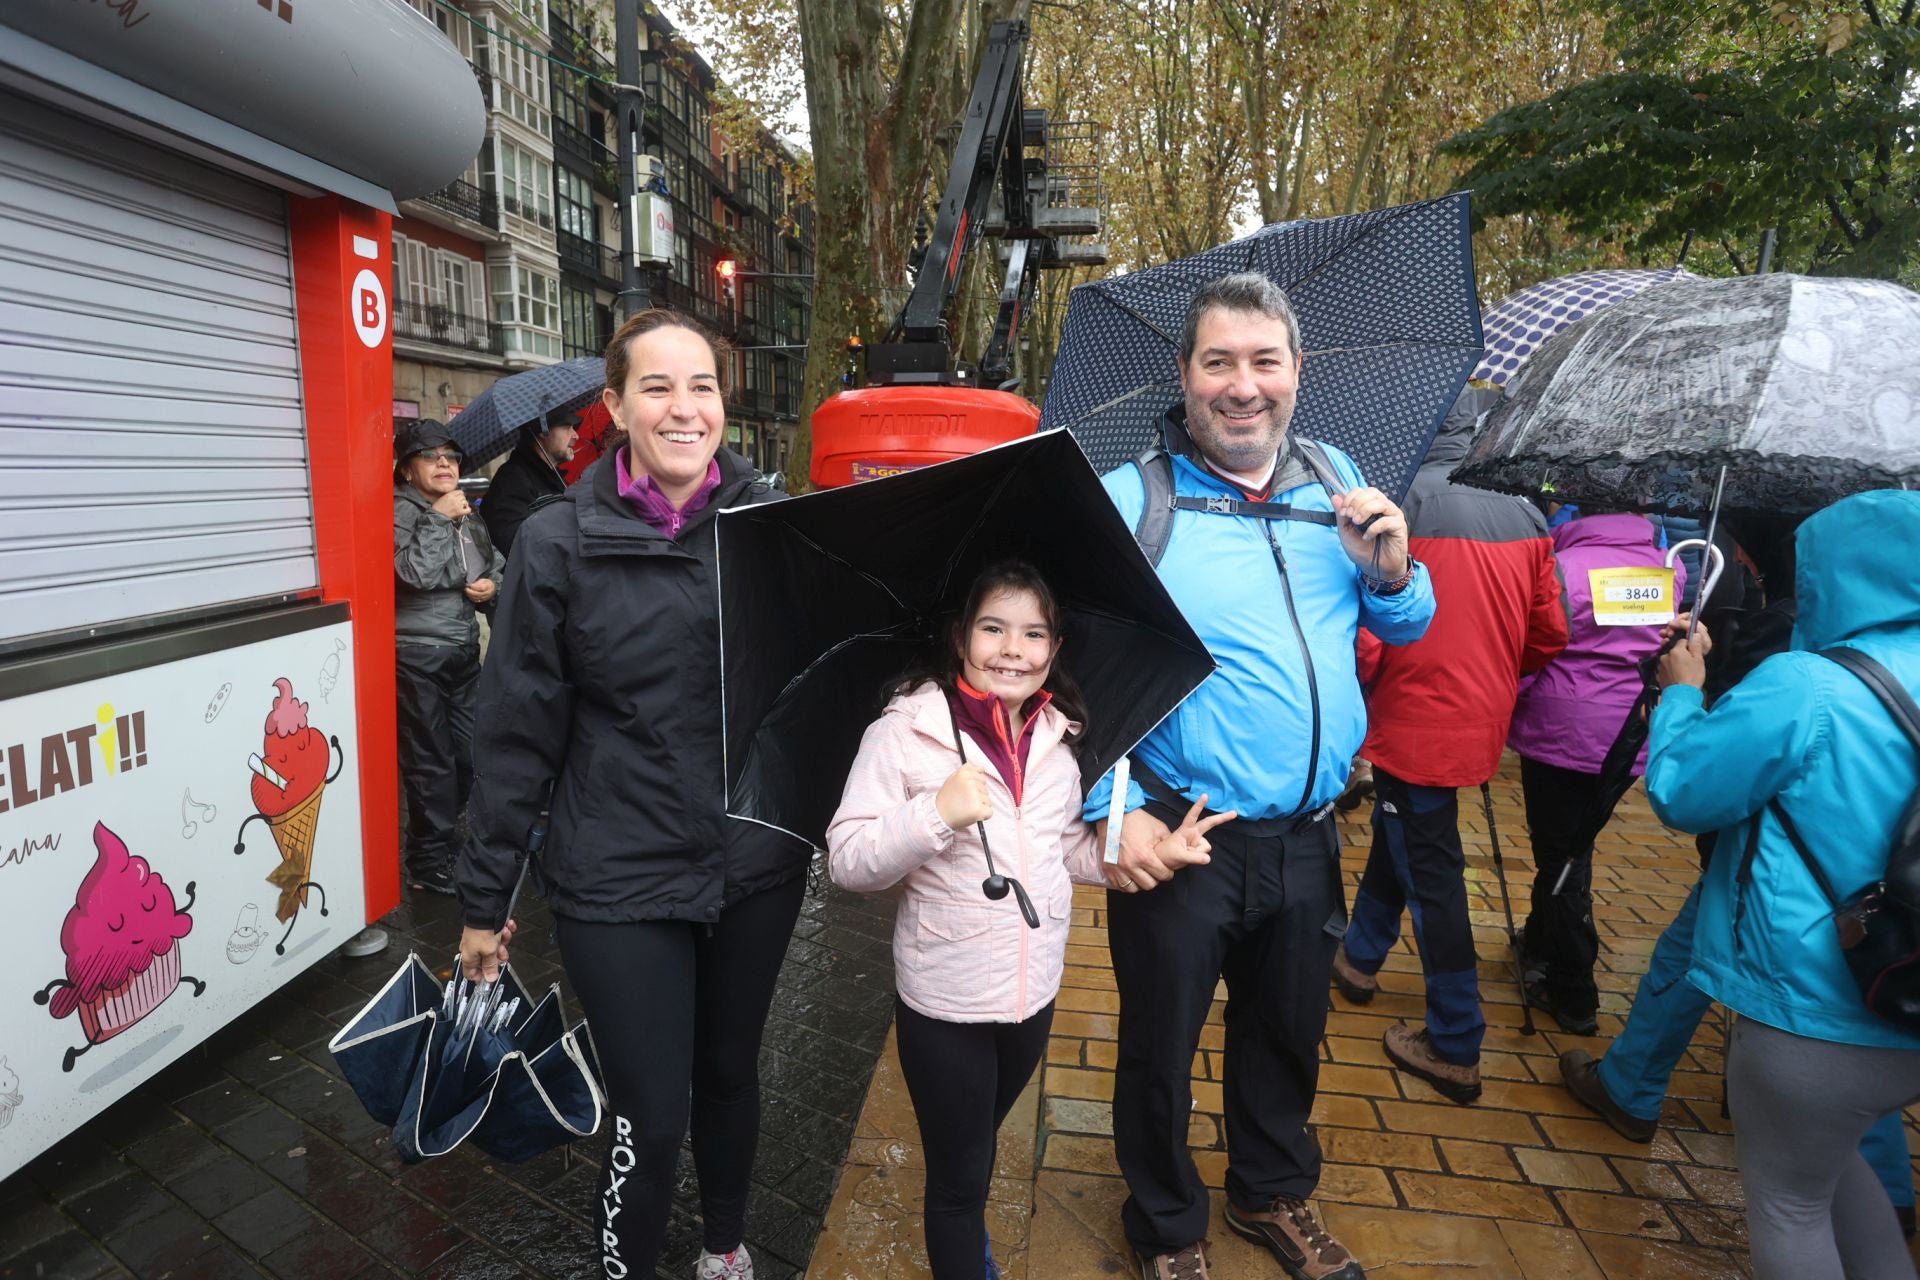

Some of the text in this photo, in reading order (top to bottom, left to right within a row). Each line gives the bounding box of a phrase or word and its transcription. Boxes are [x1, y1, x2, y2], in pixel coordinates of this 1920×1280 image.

[361, 288, 380, 329] B
[858, 414, 967, 437] MANITOU
[1625, 587, 1659, 600] 3840
